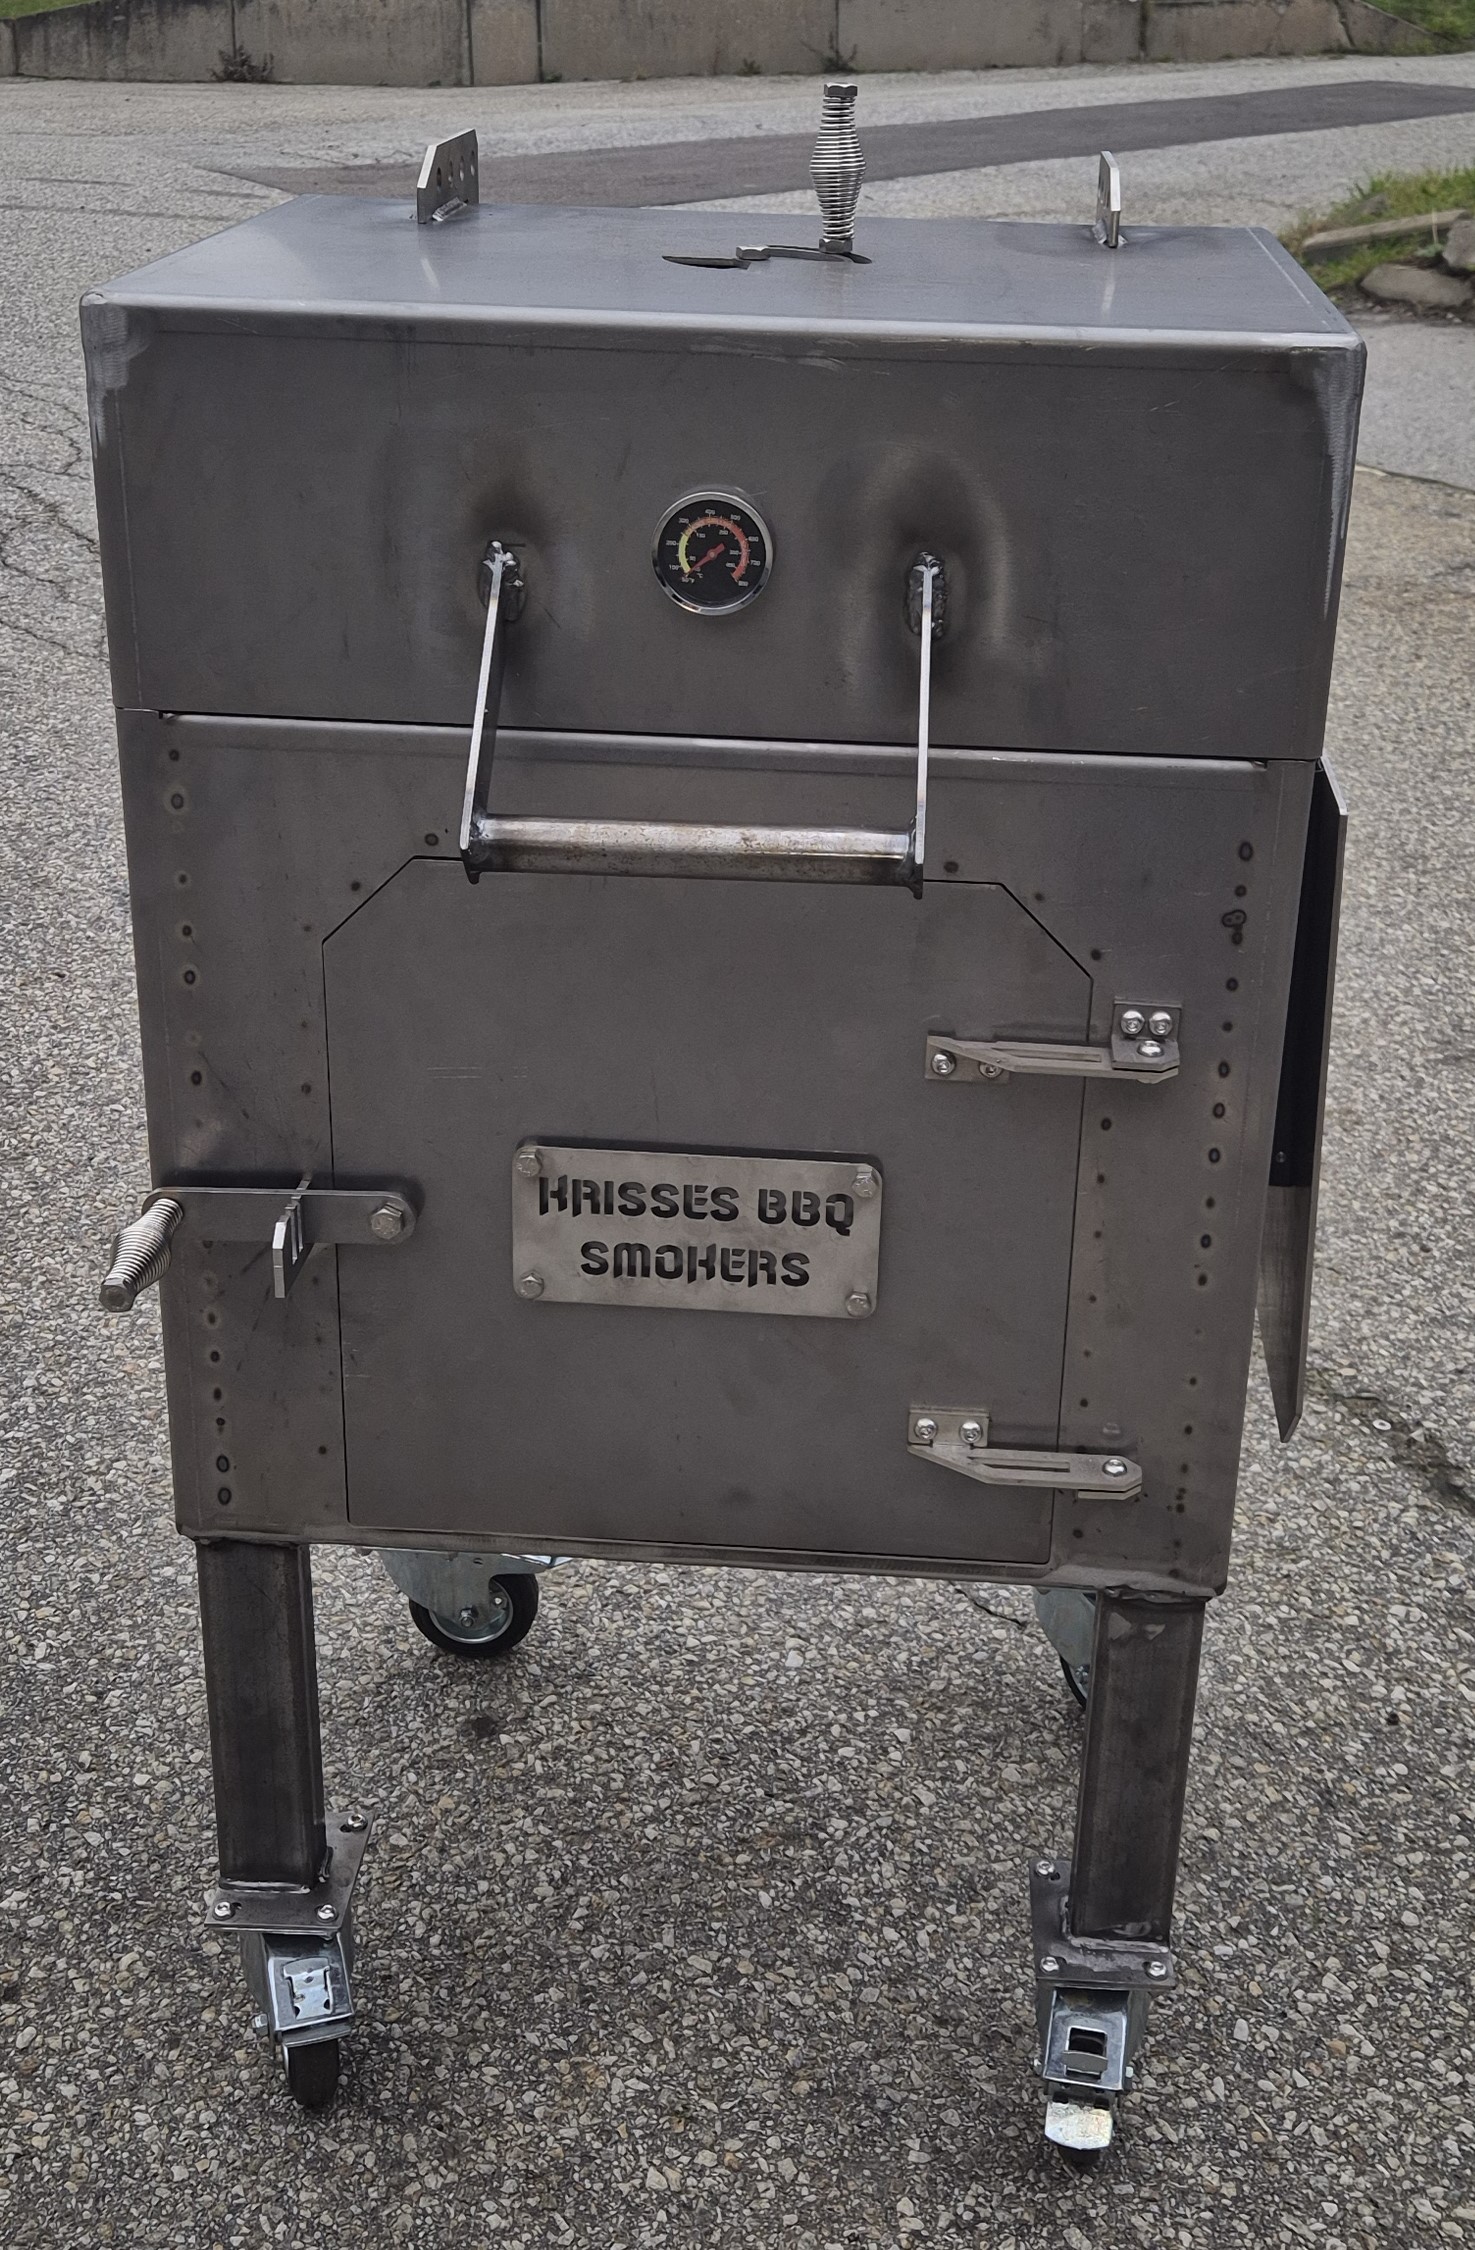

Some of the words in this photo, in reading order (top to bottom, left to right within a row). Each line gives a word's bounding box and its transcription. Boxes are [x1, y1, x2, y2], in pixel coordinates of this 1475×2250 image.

[539, 1175, 739, 1222] KRISSES
[757, 1189, 854, 1236] BBQ
[580, 1241, 810, 1288] SMOKERS
